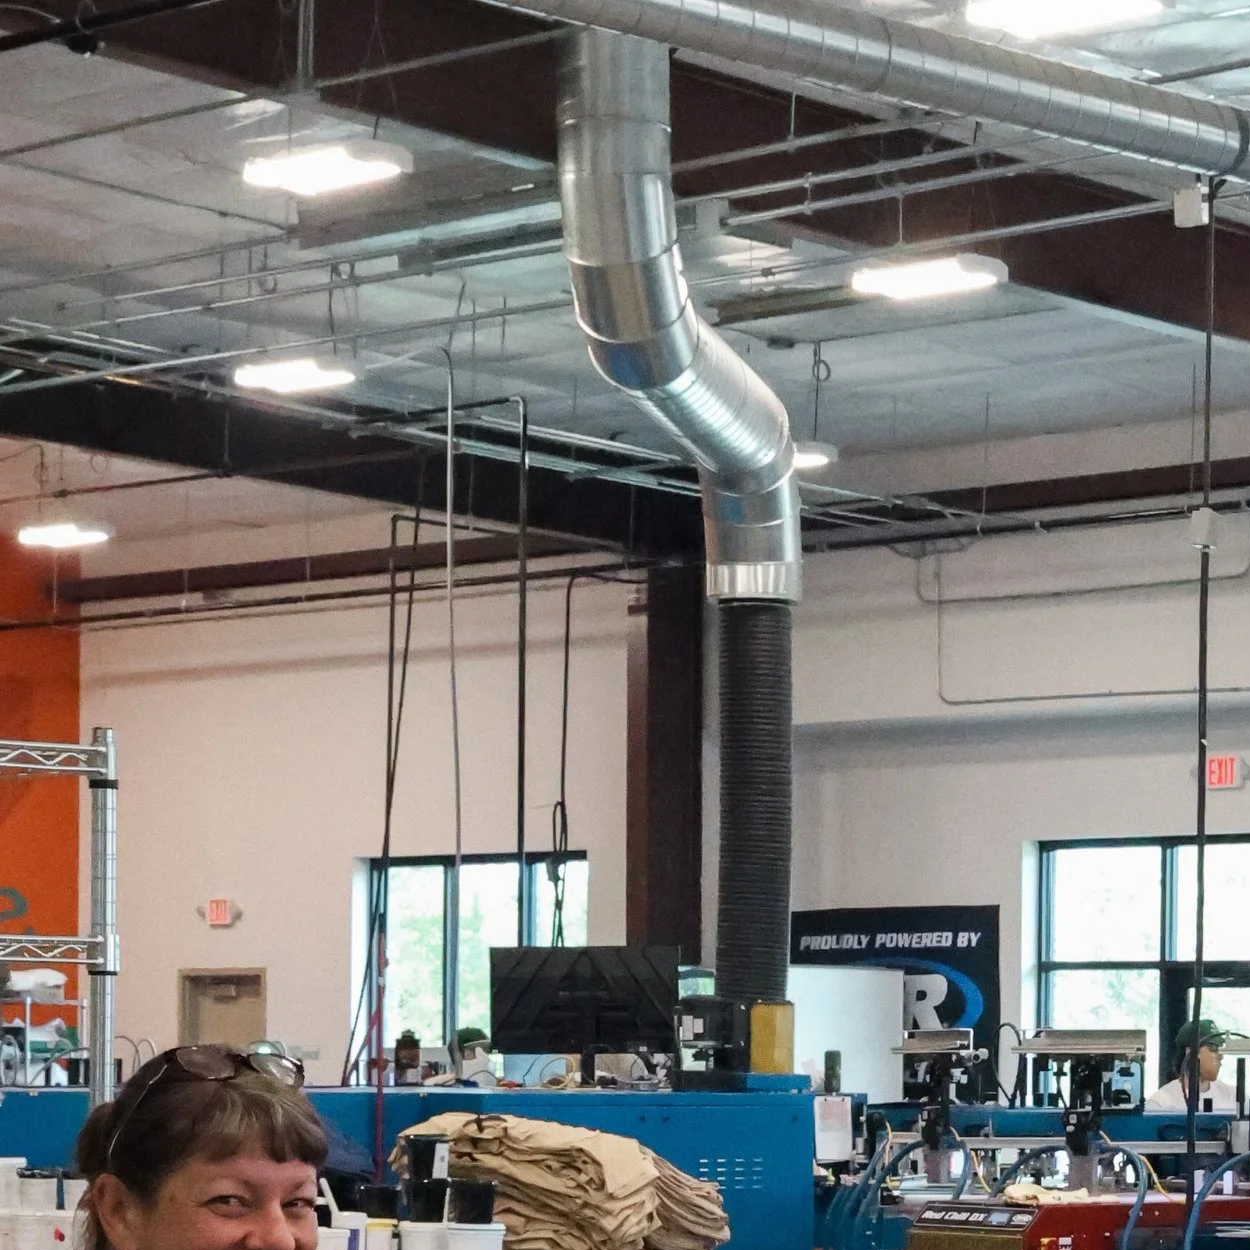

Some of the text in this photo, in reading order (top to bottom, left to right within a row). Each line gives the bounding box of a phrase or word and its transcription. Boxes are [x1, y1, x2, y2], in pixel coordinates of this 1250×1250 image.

[1208, 757, 1235, 785] EXIT
[800, 931, 981, 950] PROUDLY POWERED BY
